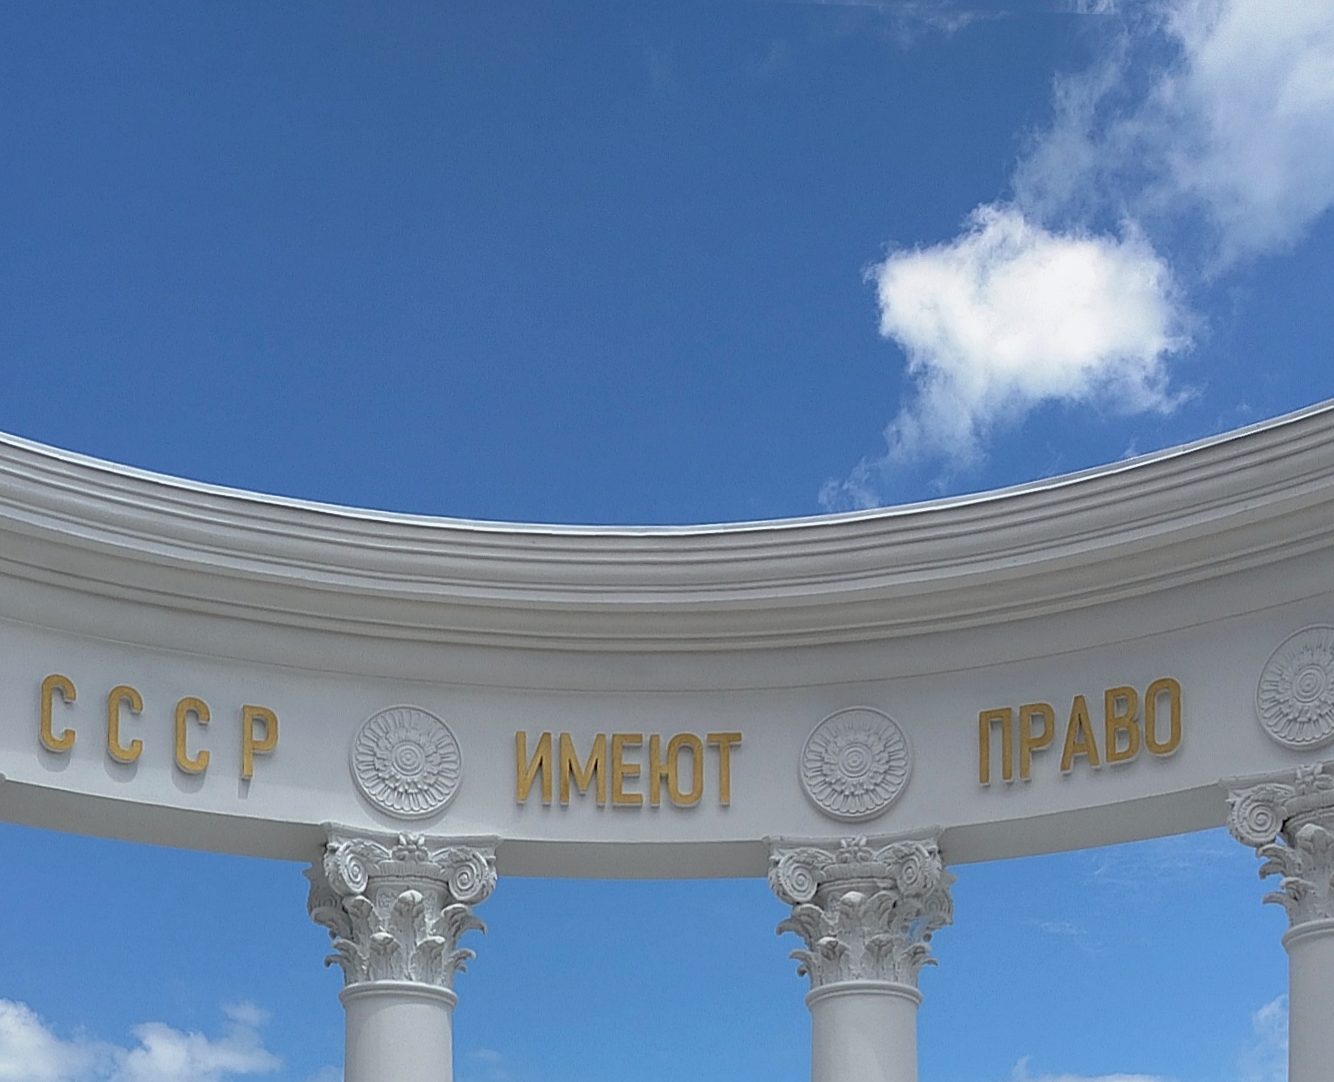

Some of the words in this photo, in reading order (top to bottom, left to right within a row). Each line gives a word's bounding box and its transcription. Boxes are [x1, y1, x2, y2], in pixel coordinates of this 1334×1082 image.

[39, 674, 279, 780] СССР
[514, 731, 742, 806] ИМЕЮТ
[978, 677, 1182, 784] ПРАВО
